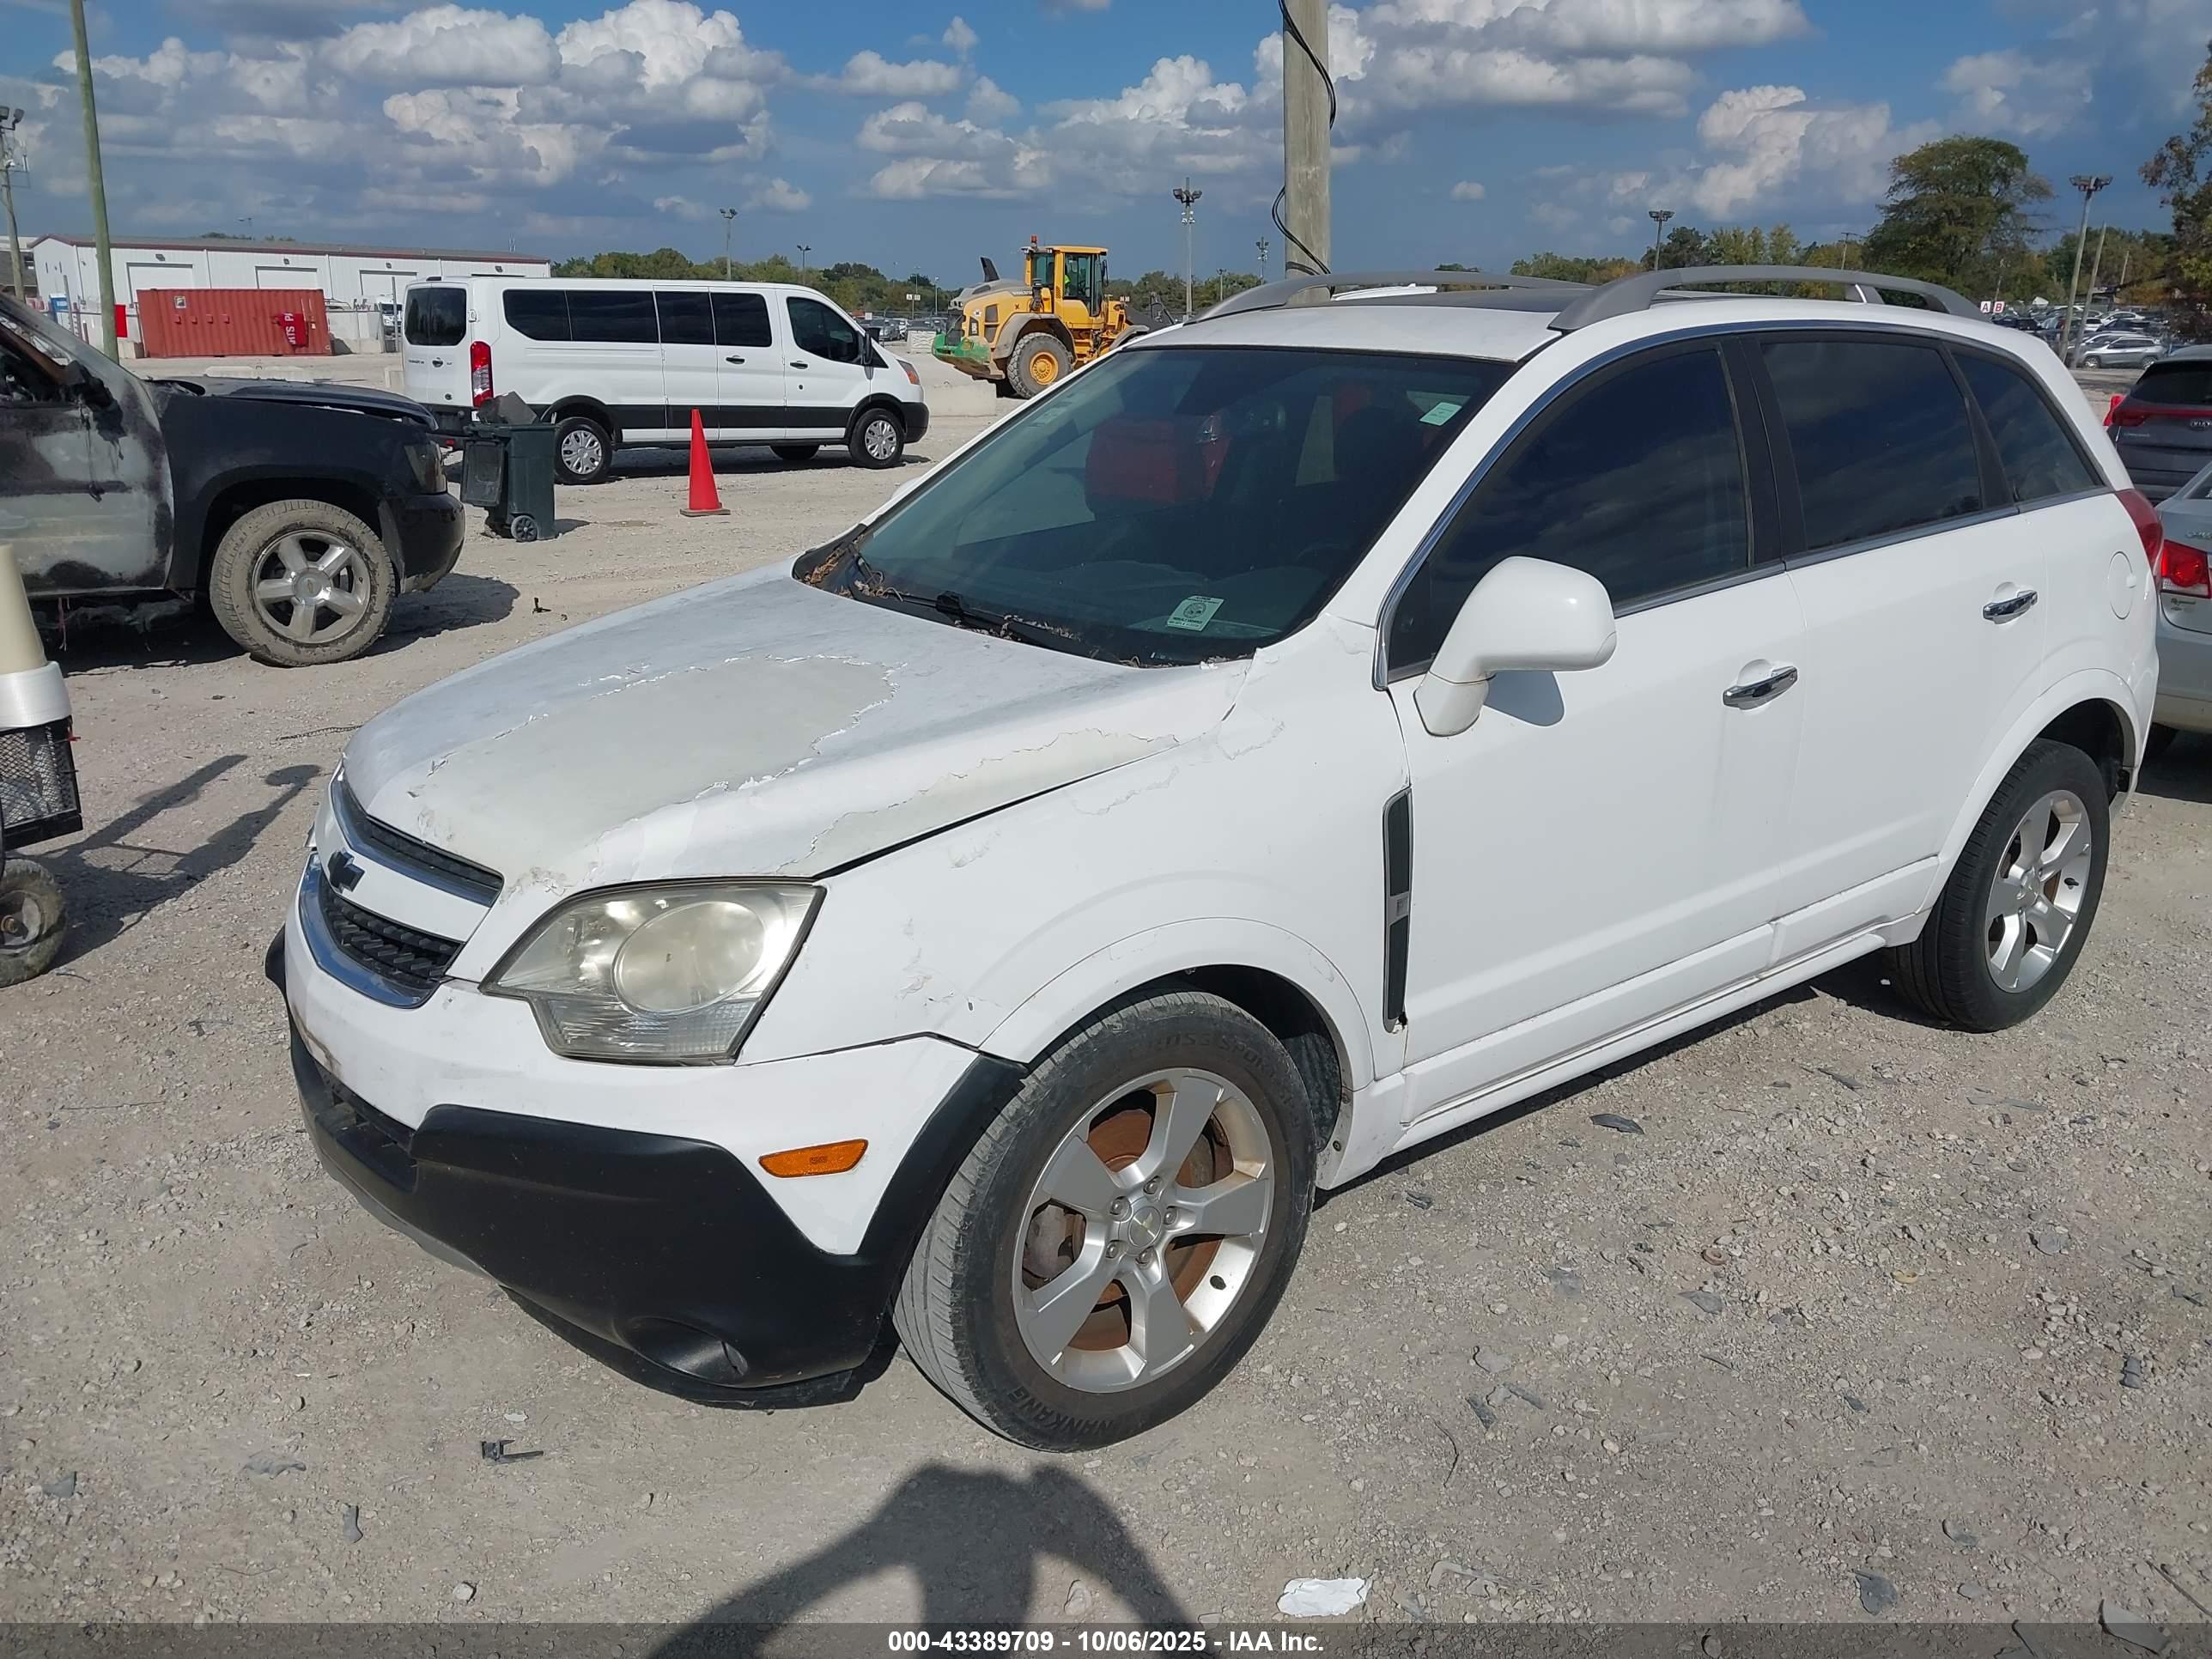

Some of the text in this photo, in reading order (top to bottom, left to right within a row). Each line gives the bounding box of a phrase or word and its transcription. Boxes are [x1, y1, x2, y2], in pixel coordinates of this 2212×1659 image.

[1982, 302, 1989, 312] A
[1996, 302, 2002, 312] B
[1007, 1385, 1114, 1437] NANKANG
